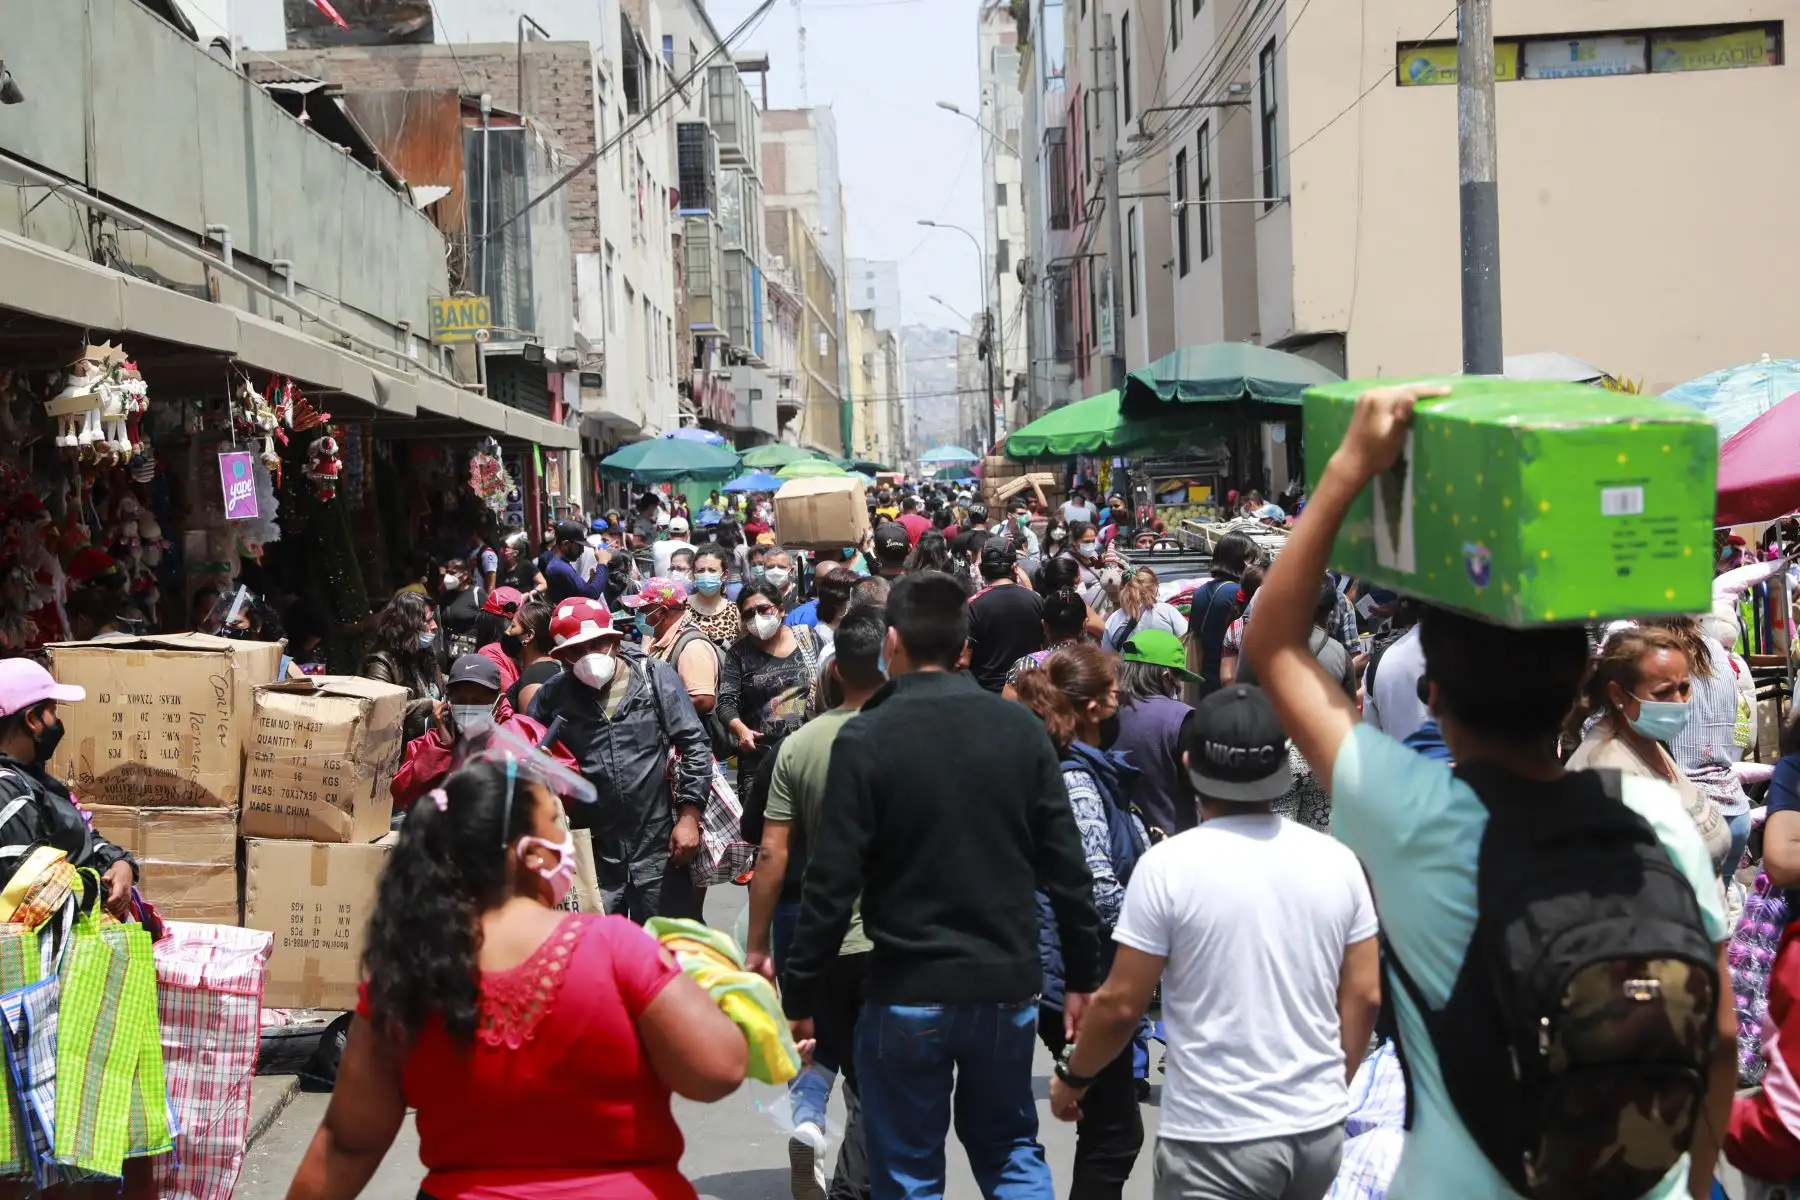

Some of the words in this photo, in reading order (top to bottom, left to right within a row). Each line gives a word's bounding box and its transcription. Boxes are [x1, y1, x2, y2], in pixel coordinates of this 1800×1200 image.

[229, 479, 253, 511] yape
[99, 693, 111, 704] CM
[112, 712, 123, 722] KG
[140, 713, 149, 722] 20
[259, 717, 277, 728] ITEM
[112, 731, 123, 740] KG
[257, 734, 297, 748] QUANTITY:
[304, 739, 313, 750] 48
[108, 749, 121, 759] PCS
[139, 749, 148, 759] 72
[1205, 740, 1247, 768] NIKE
[323, 759, 341, 770] KGS
[322, 776, 340, 787] KGS
[251, 784, 276, 796] MEAS:
[325, 793, 338, 803] CM
[249, 801, 272, 813] MADE
[274, 803, 284, 814] IN
[285, 805, 311, 818] CHINA
[291, 902, 304, 912] KGS
[290, 914, 304, 924] KGS
[290, 927, 303, 937] PCS
